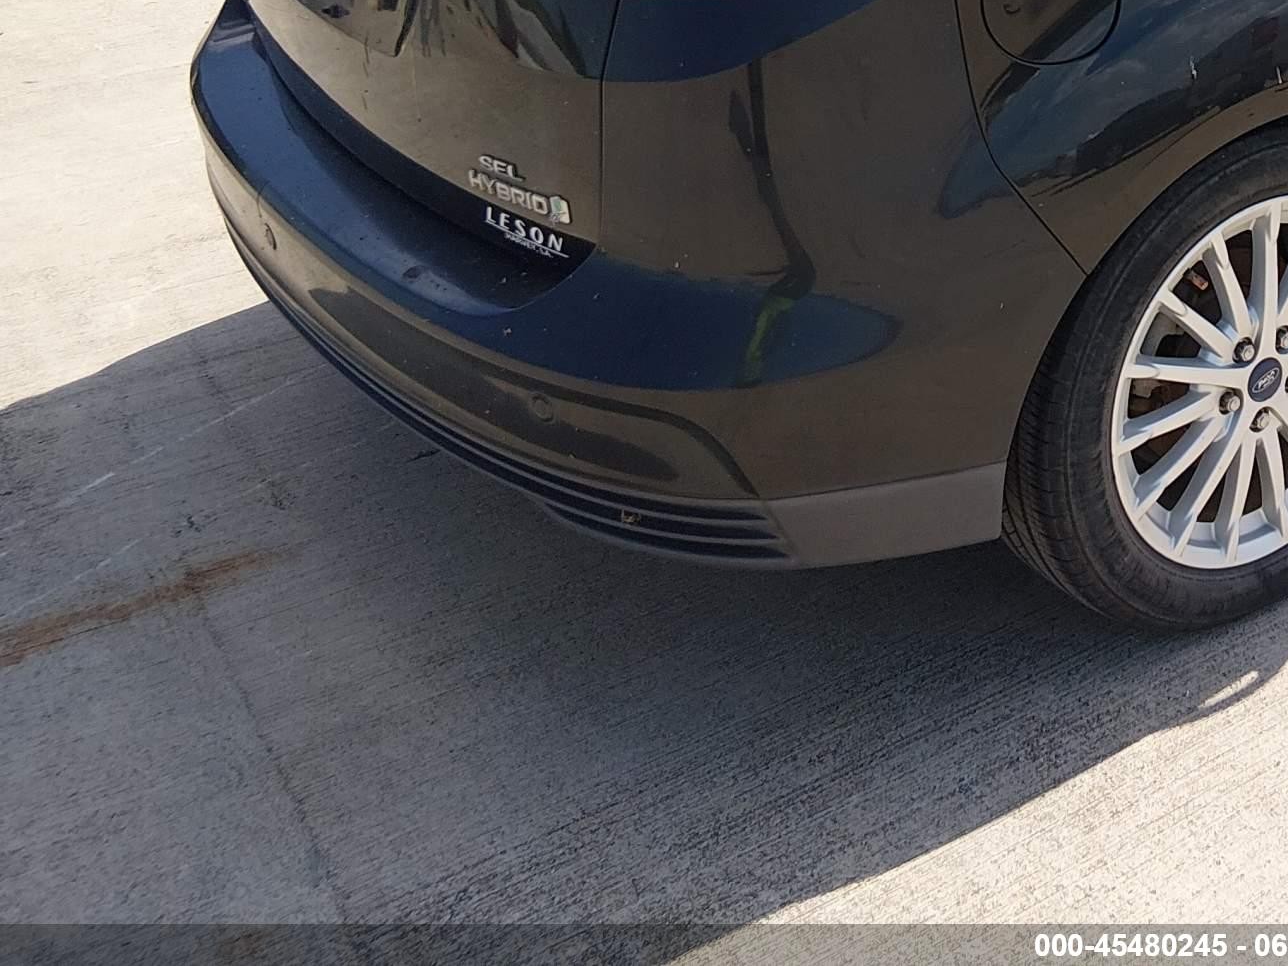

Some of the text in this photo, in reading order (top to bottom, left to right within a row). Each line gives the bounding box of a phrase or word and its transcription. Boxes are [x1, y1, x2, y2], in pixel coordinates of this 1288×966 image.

[477, 154, 525, 182] SEL
[468, 169, 550, 216] HYBRID
[485, 205, 564, 252] LESON
